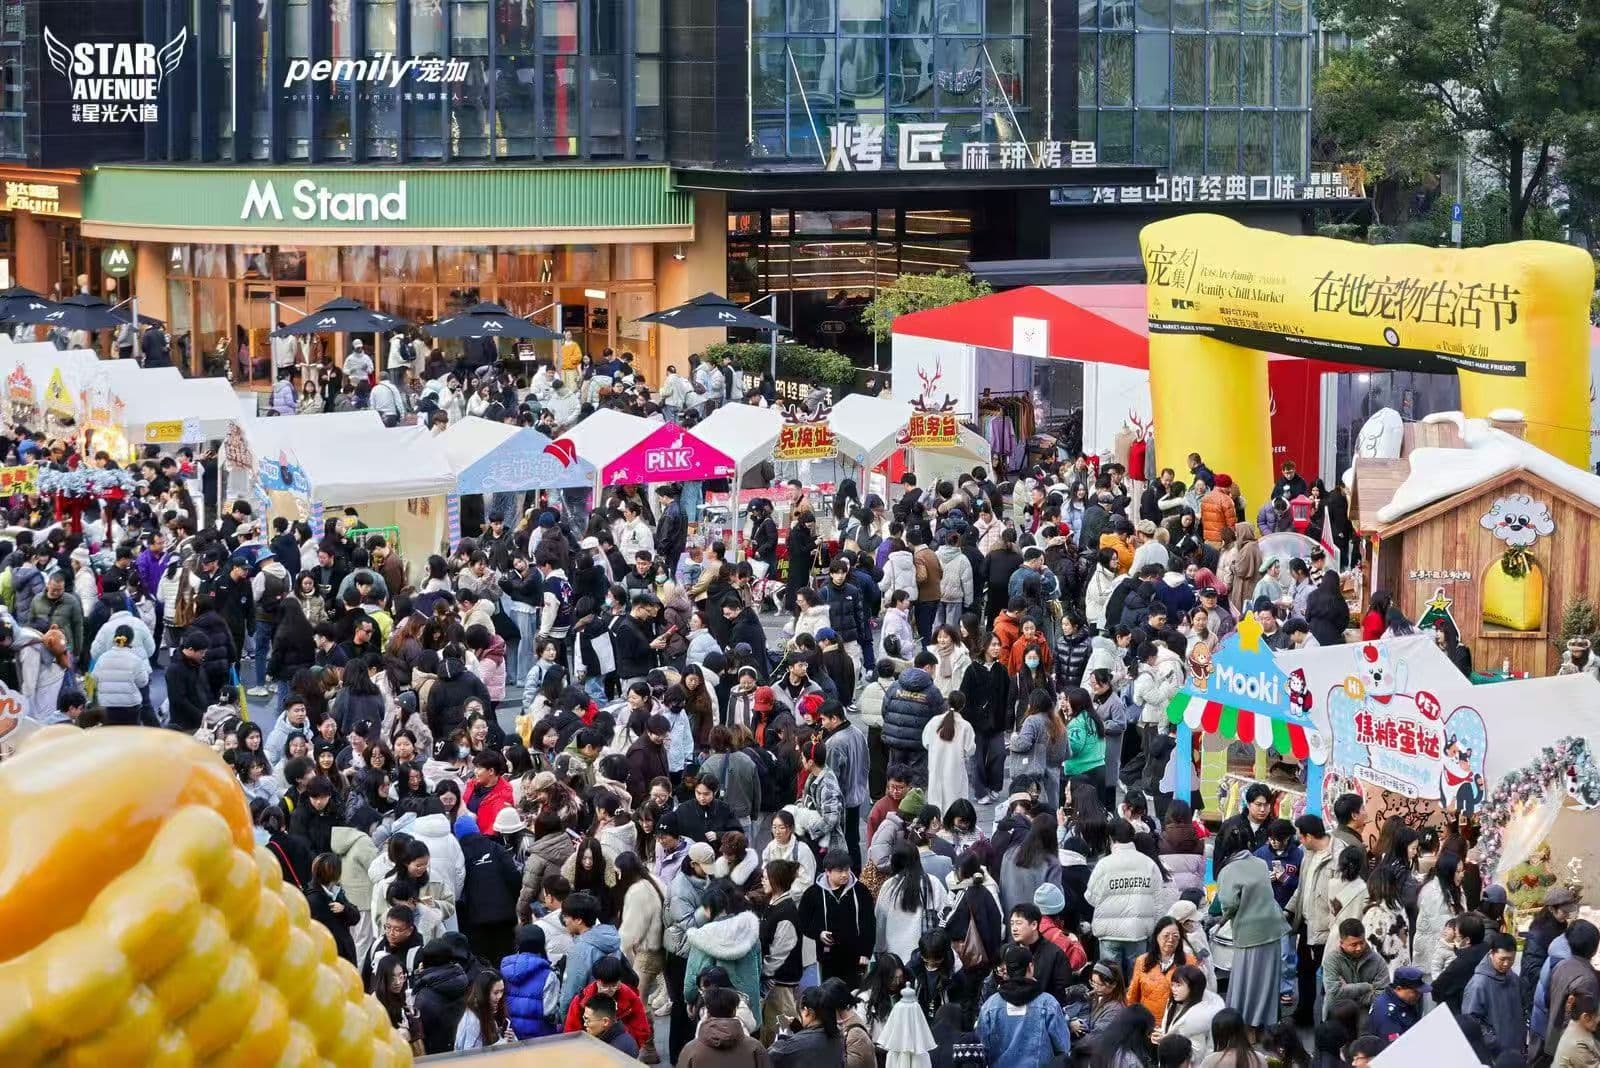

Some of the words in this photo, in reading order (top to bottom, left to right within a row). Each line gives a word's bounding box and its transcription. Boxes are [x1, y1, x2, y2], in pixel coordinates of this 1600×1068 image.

[826, 122, 948, 171] 烤匠
[961, 141, 1097, 169] 麻辣烤鱼
[240, 179, 283, 219] M
[292, 179, 407, 220] Stand
[1454, 205, 1460, 218] P
[1251, 289, 1285, 304] Market
[1310, 270, 1521, 331] 在地宠物生活节
[1490, 363, 1517, 372] FRIENDS
[910, 416, 955, 436] 服务台
[781, 427, 832, 449] 兑换处
[1215, 663, 1279, 705] Mooki
[1347, 678, 1360, 695] Hi
[1418, 695, 1440, 718] PET
[1355, 711, 1440, 759] 焦糖蛋挞
[1109, 876, 1151, 890] GEORGEPAZ
